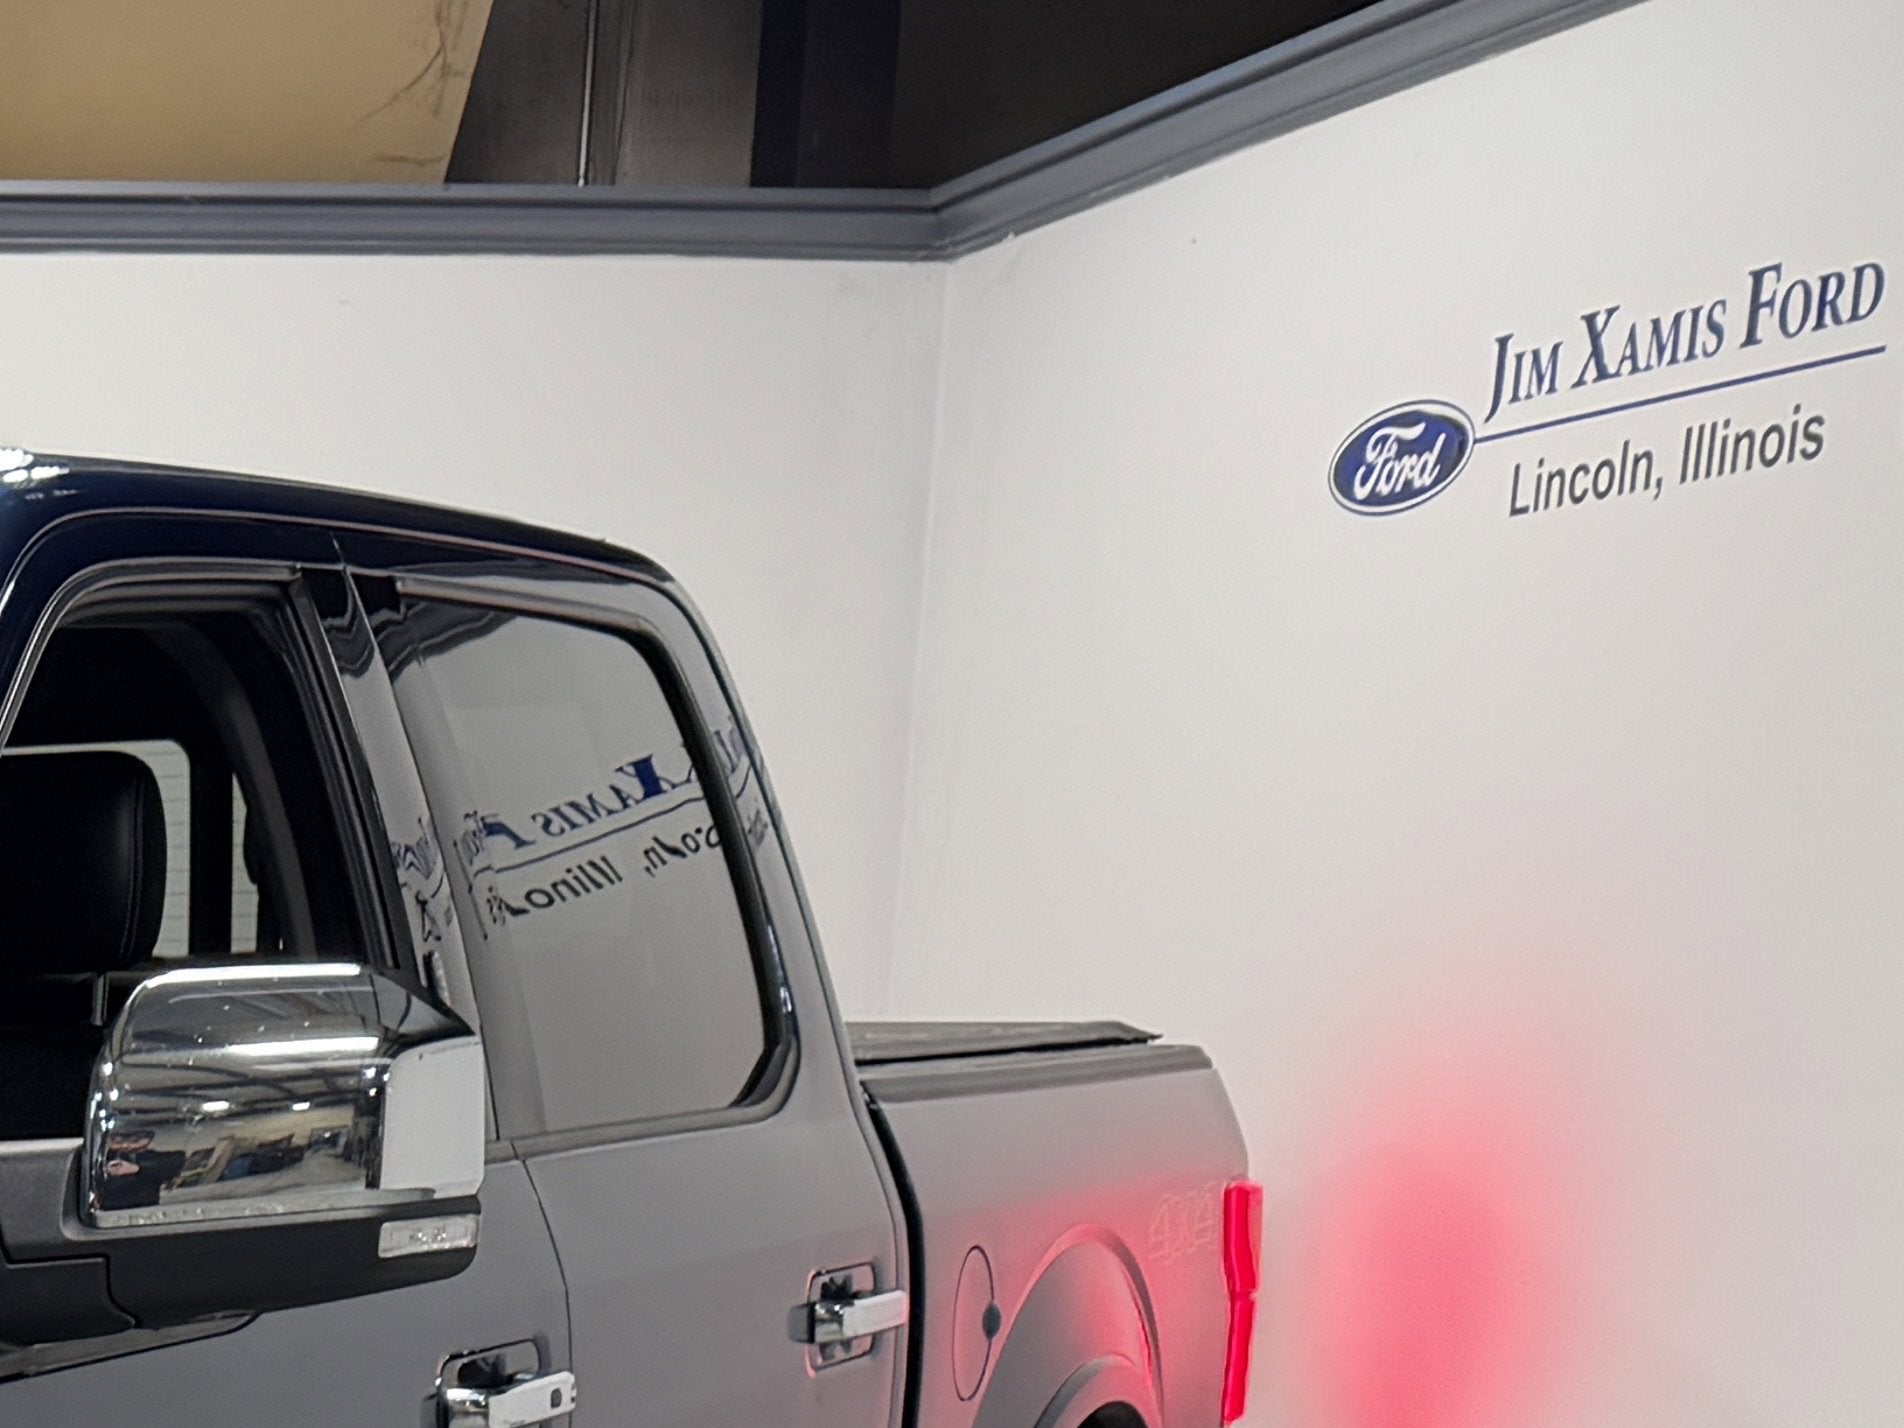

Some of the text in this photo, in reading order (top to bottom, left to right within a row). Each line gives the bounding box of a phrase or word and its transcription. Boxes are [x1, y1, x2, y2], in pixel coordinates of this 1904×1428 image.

[1354, 421, 1447, 500] Ford
[1509, 404, 1825, 518] Lincoln, Illinois
